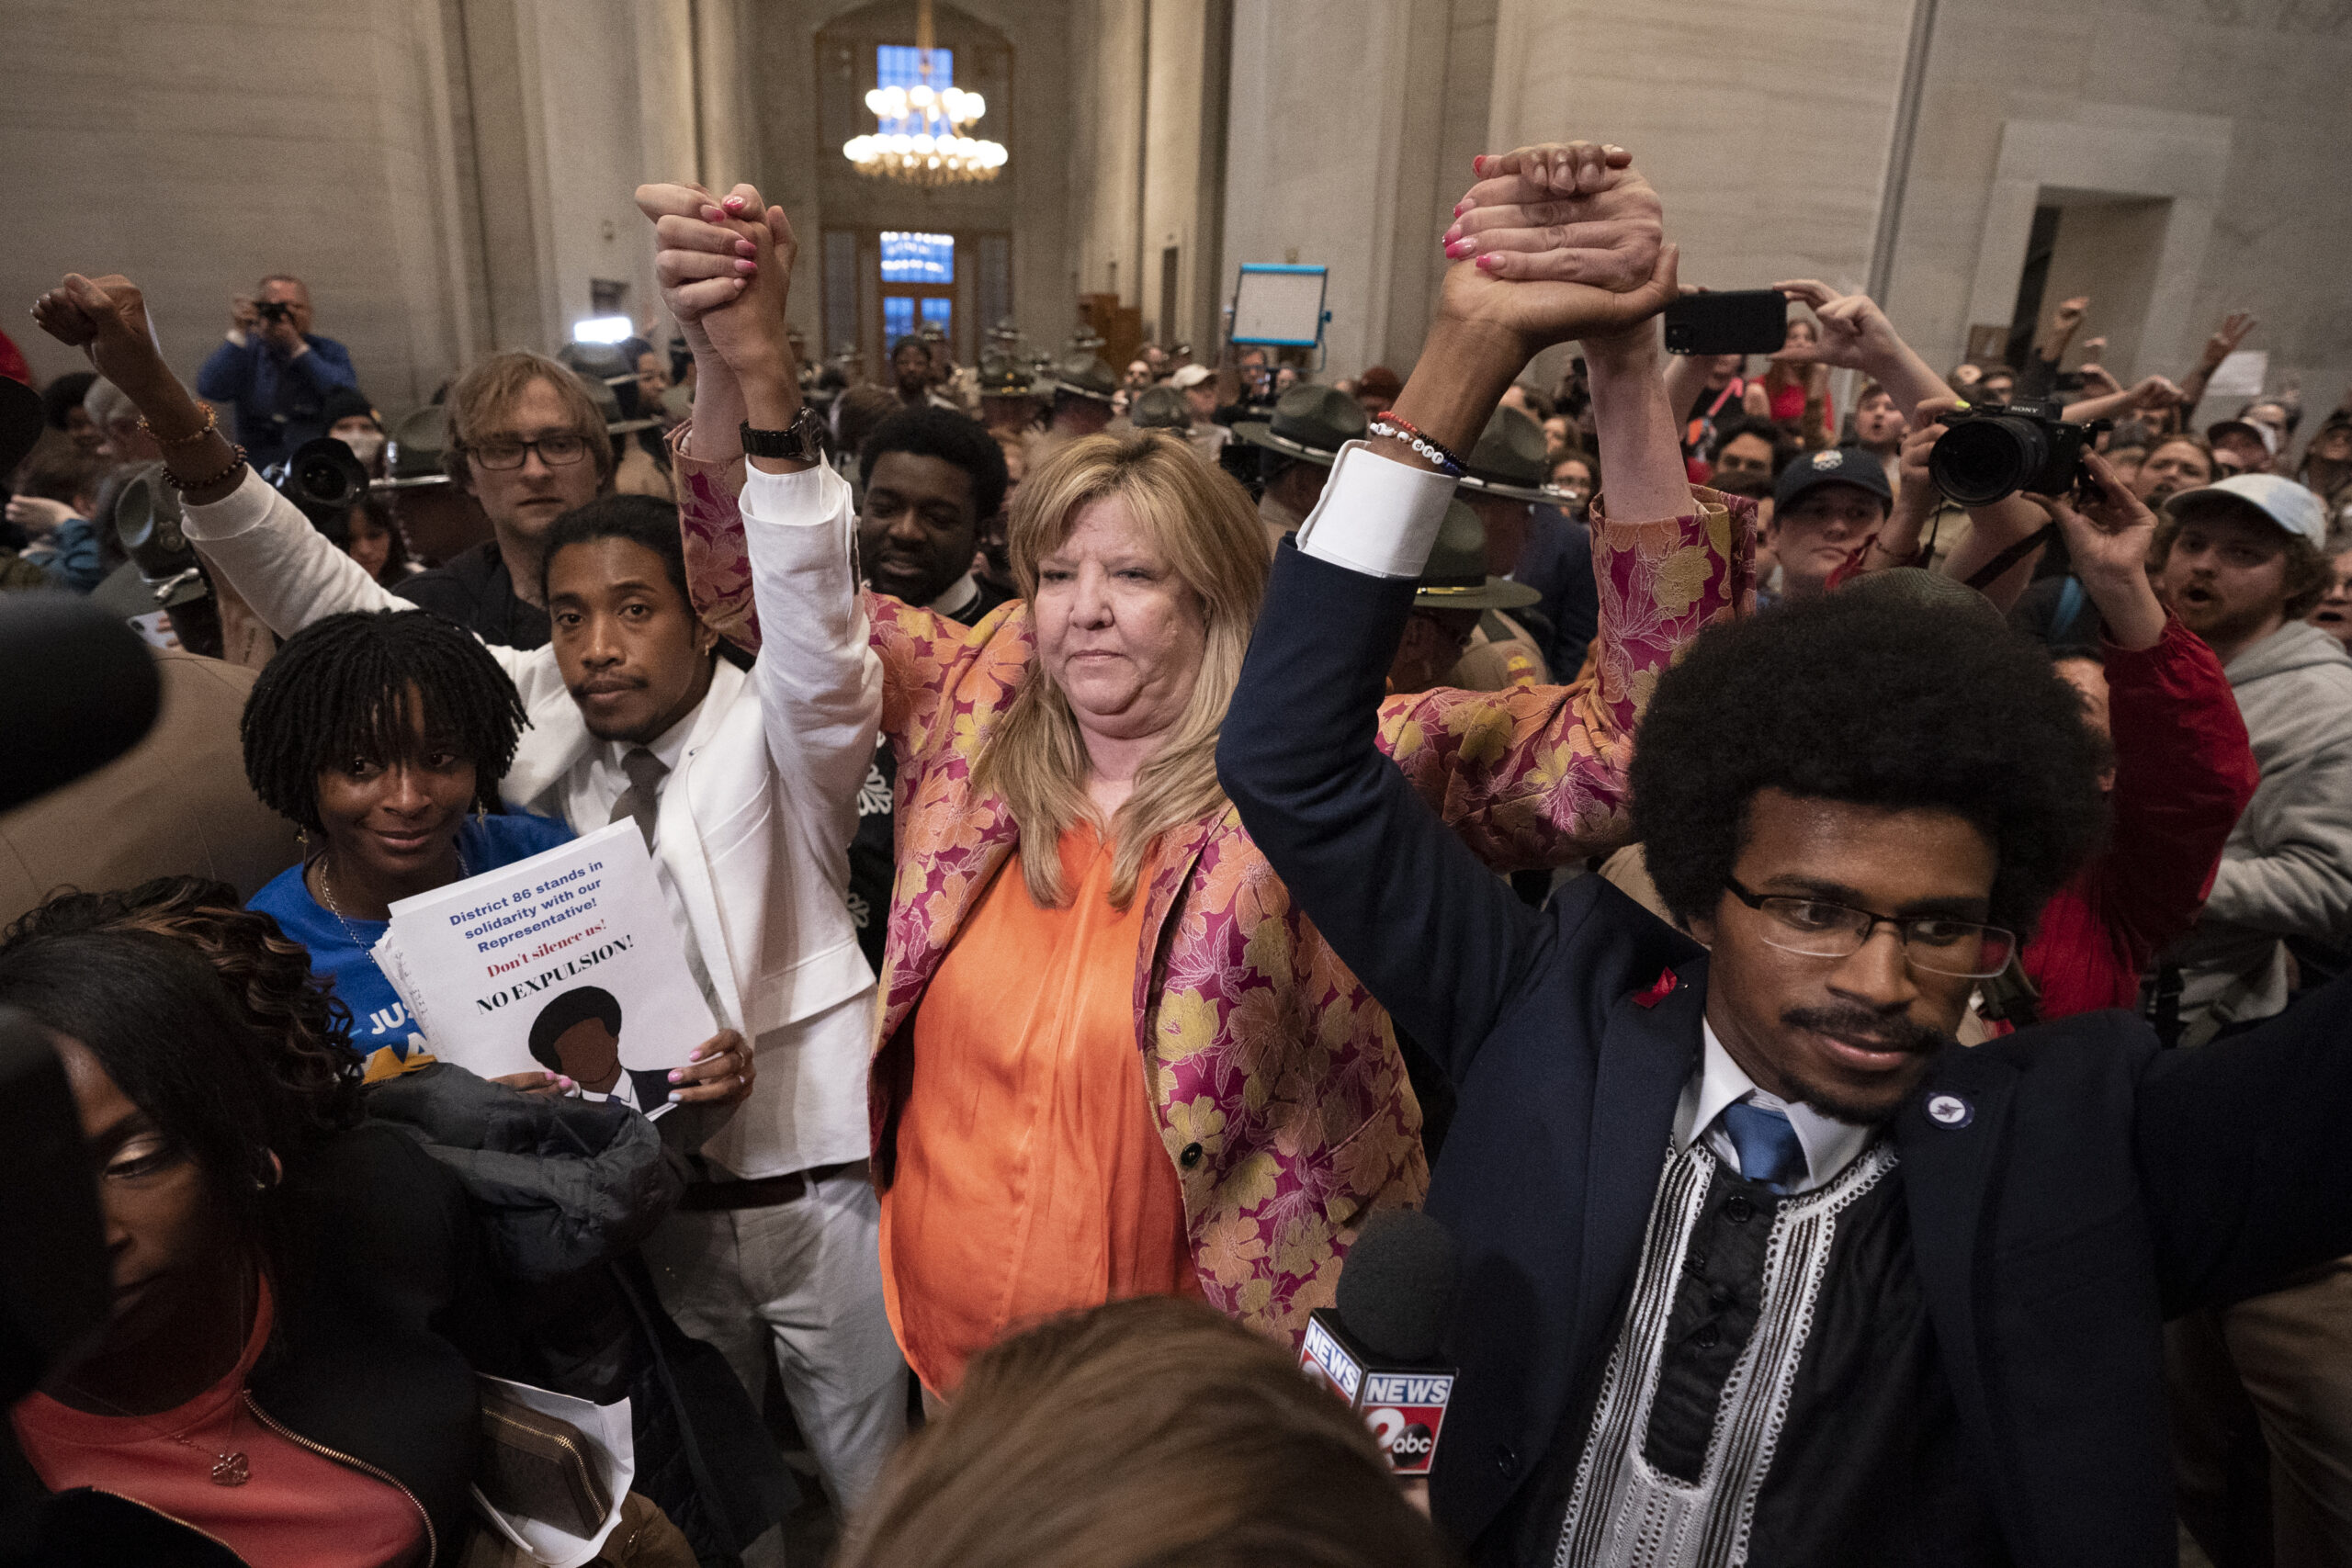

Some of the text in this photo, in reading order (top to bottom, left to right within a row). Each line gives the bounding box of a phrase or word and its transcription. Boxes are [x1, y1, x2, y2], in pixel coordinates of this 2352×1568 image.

[2010, 405, 2039, 413] SONY
[449, 860, 604, 926] District 86 stands in
[465, 879, 602, 940] solidarity with our
[477, 897, 598, 953] Representative!
[486, 919, 606, 978] Don't silence us!
[476, 991, 509, 1015] NO
[511, 934, 634, 1001] EXPULSION!
[1306, 1325, 1358, 1394] NEWS
[1365, 1378, 1449, 1404] NEWS
[1392, 1432, 1431, 1453] abc
